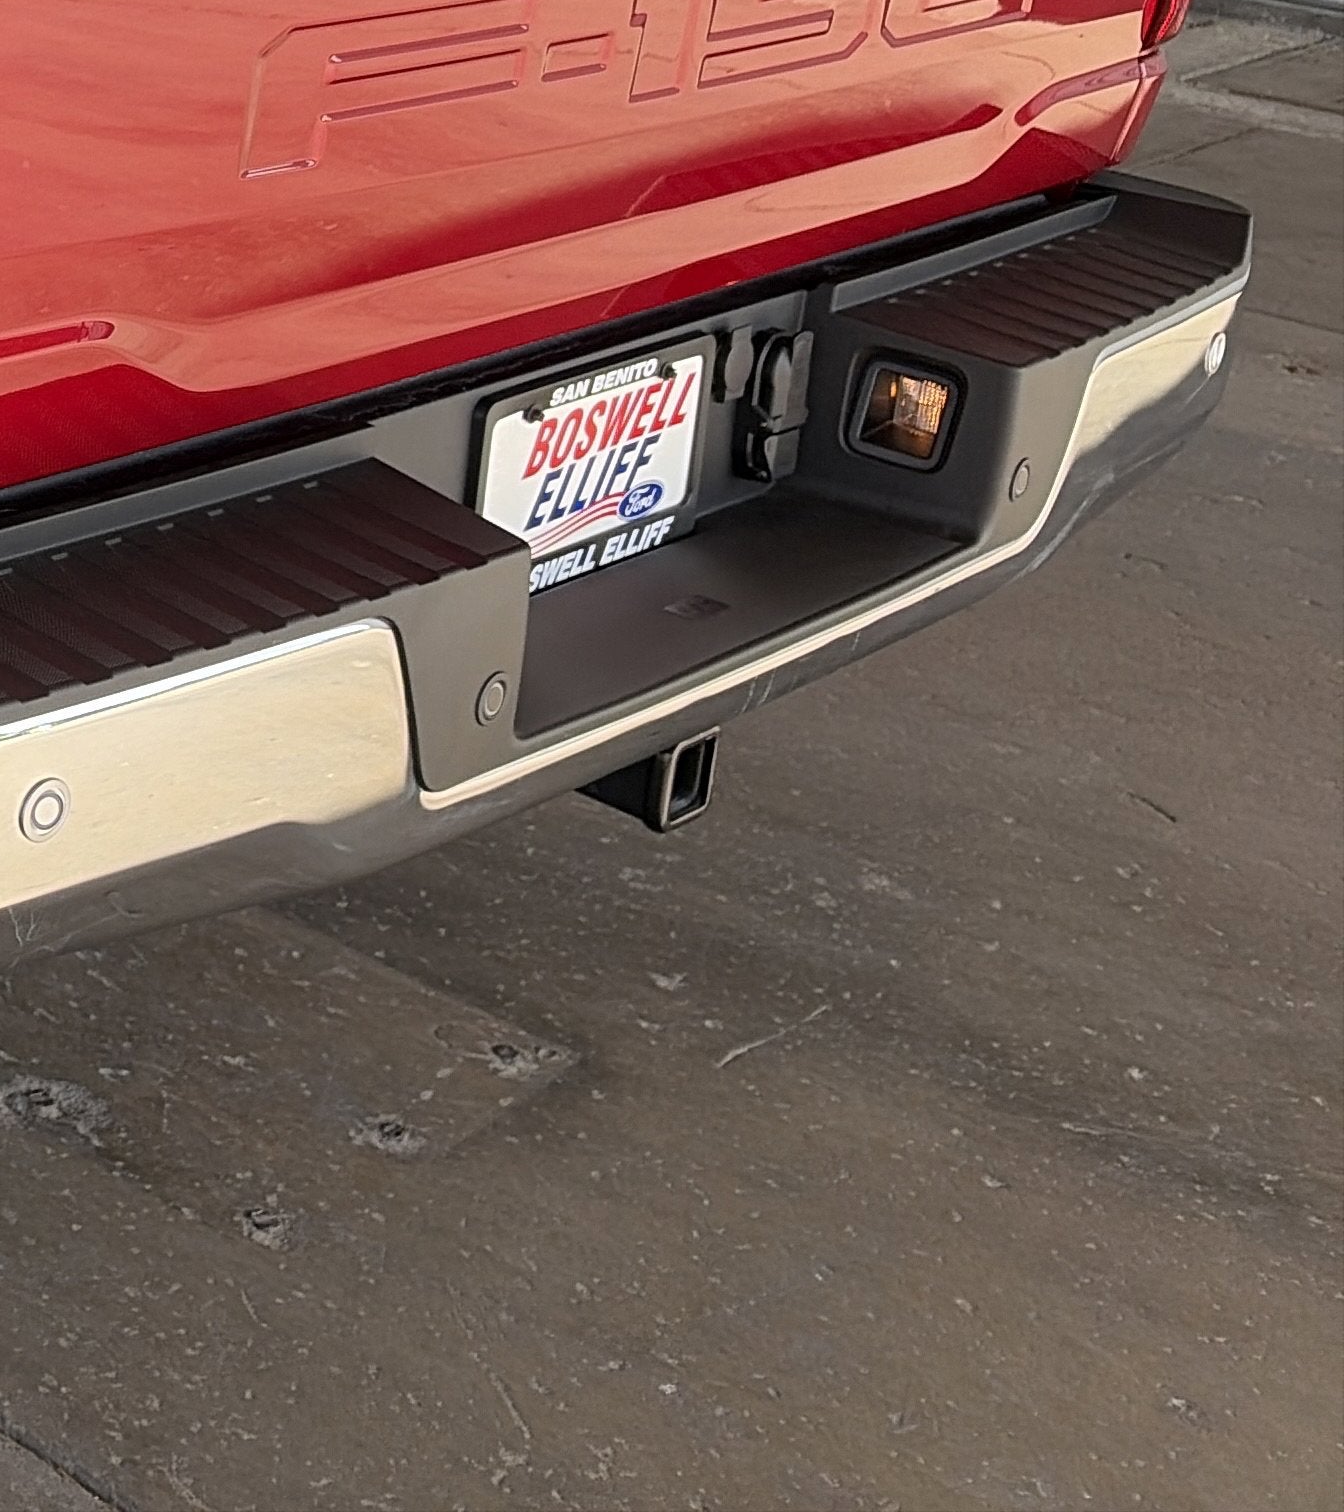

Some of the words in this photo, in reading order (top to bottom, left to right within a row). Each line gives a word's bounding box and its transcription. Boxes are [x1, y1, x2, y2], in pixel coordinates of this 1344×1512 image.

[549, 380, 592, 407] SAN
[591, 357, 659, 395] BENITO
[522, 373, 696, 479] BOSWELL
[523, 433, 662, 531] ELLIFF
[624, 487, 657, 517] Ford
[599, 515, 675, 567] ELLIFF
